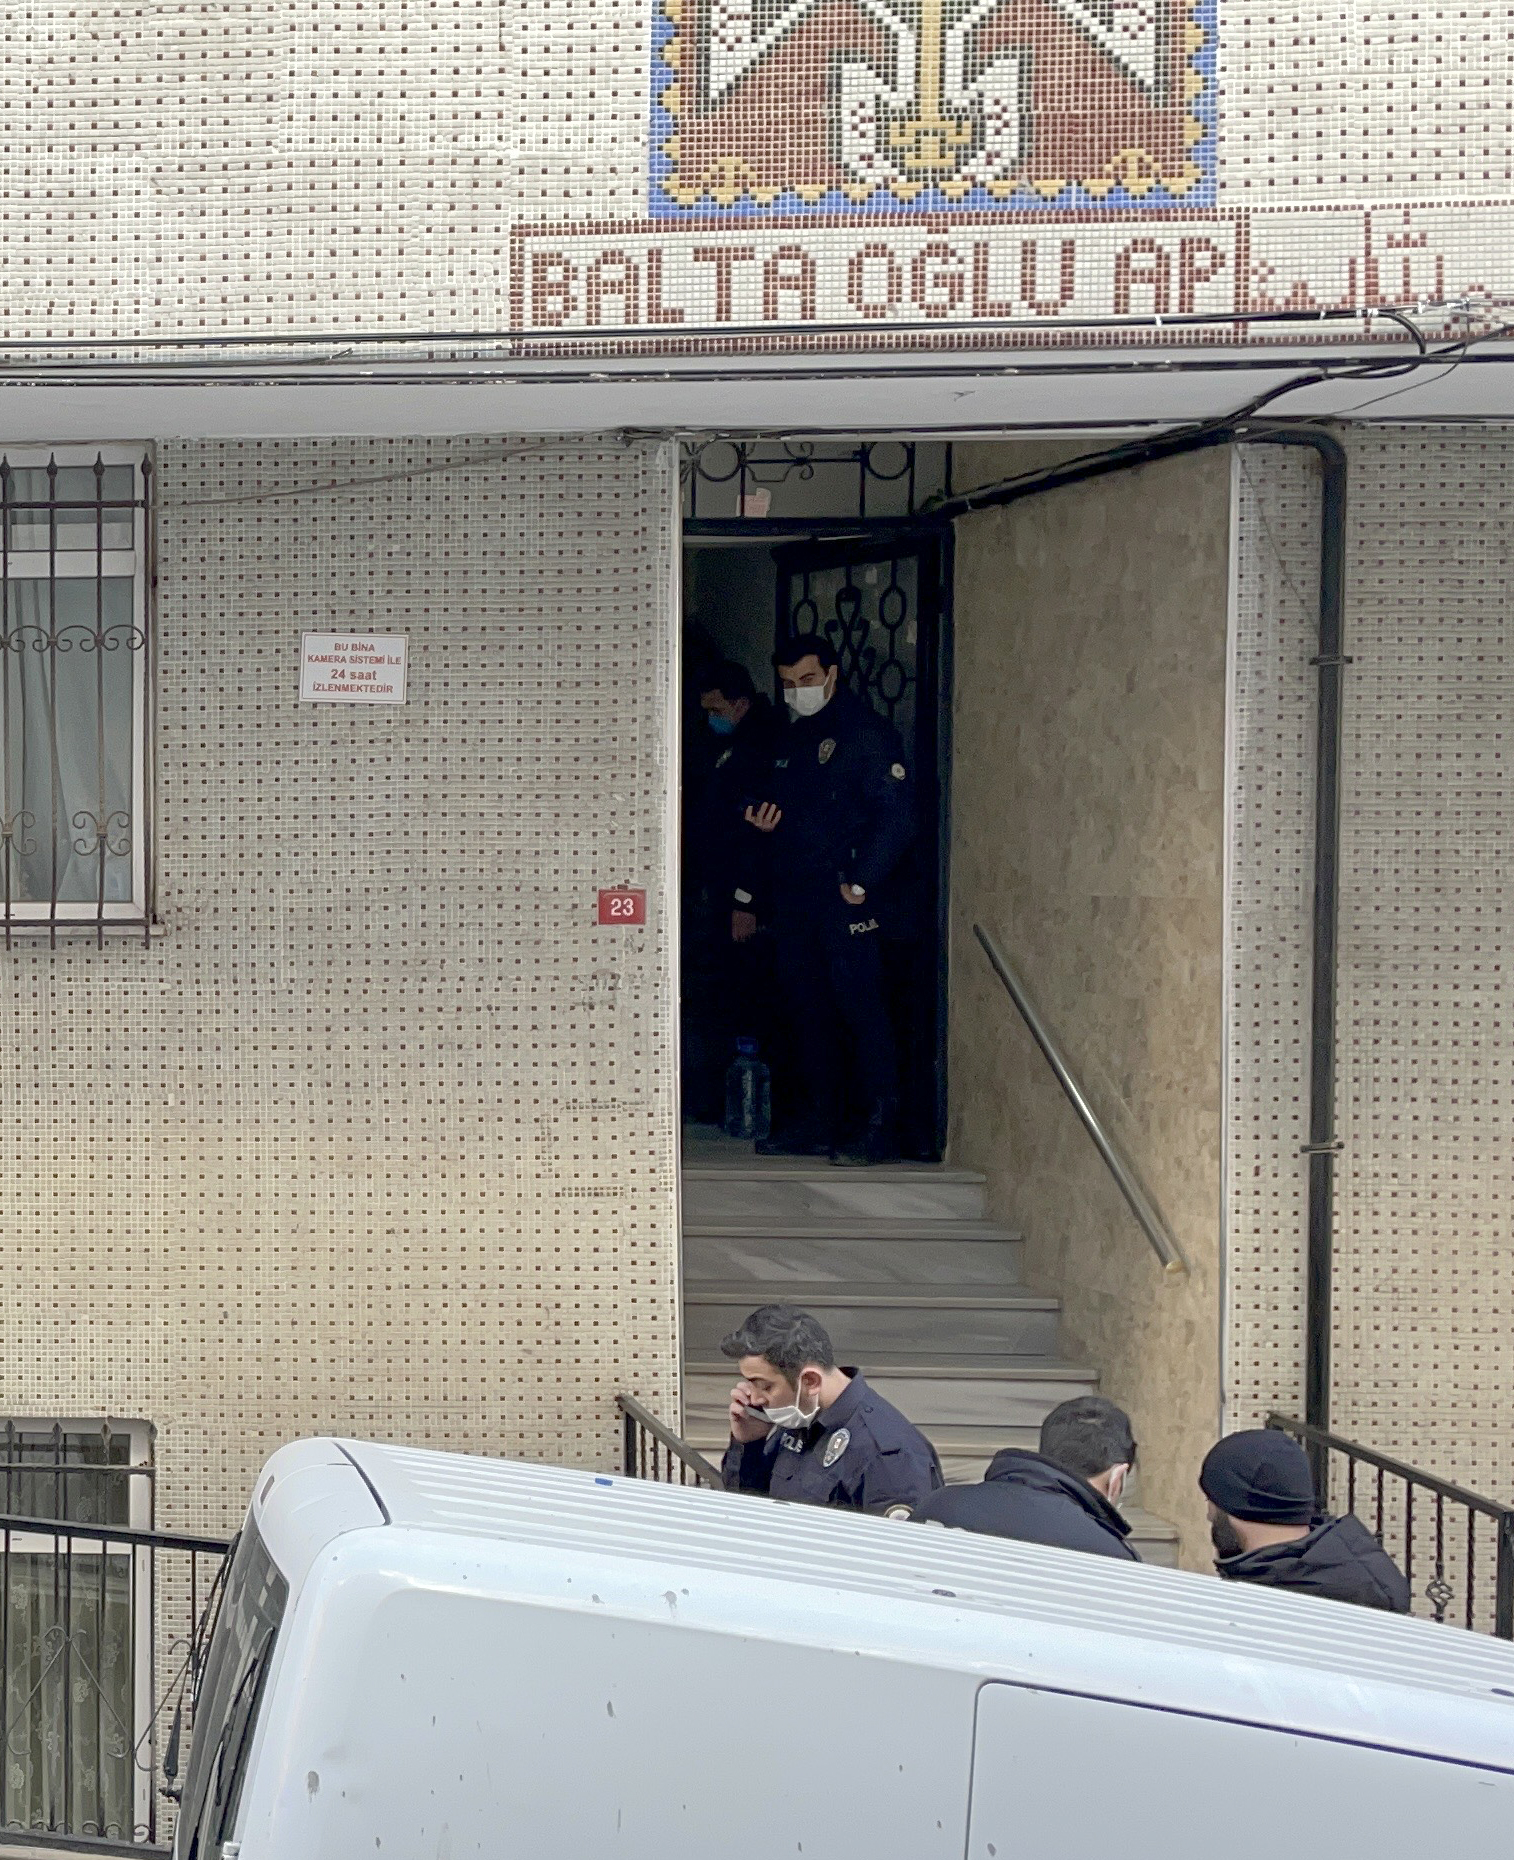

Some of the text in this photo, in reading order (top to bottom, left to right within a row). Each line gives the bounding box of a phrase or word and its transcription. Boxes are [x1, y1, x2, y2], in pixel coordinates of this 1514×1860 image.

[532, 243, 817, 328] BALTA
[1113, 236, 1227, 315] AP
[334, 641, 376, 653] BU BİNA
[307, 654, 402, 665] KAMERA SİSTEMİ İLE
[330, 668, 377, 681] 24 saat
[312, 680, 394, 694] İZLENMEKTEDİR
[610, 897, 635, 917] 23
